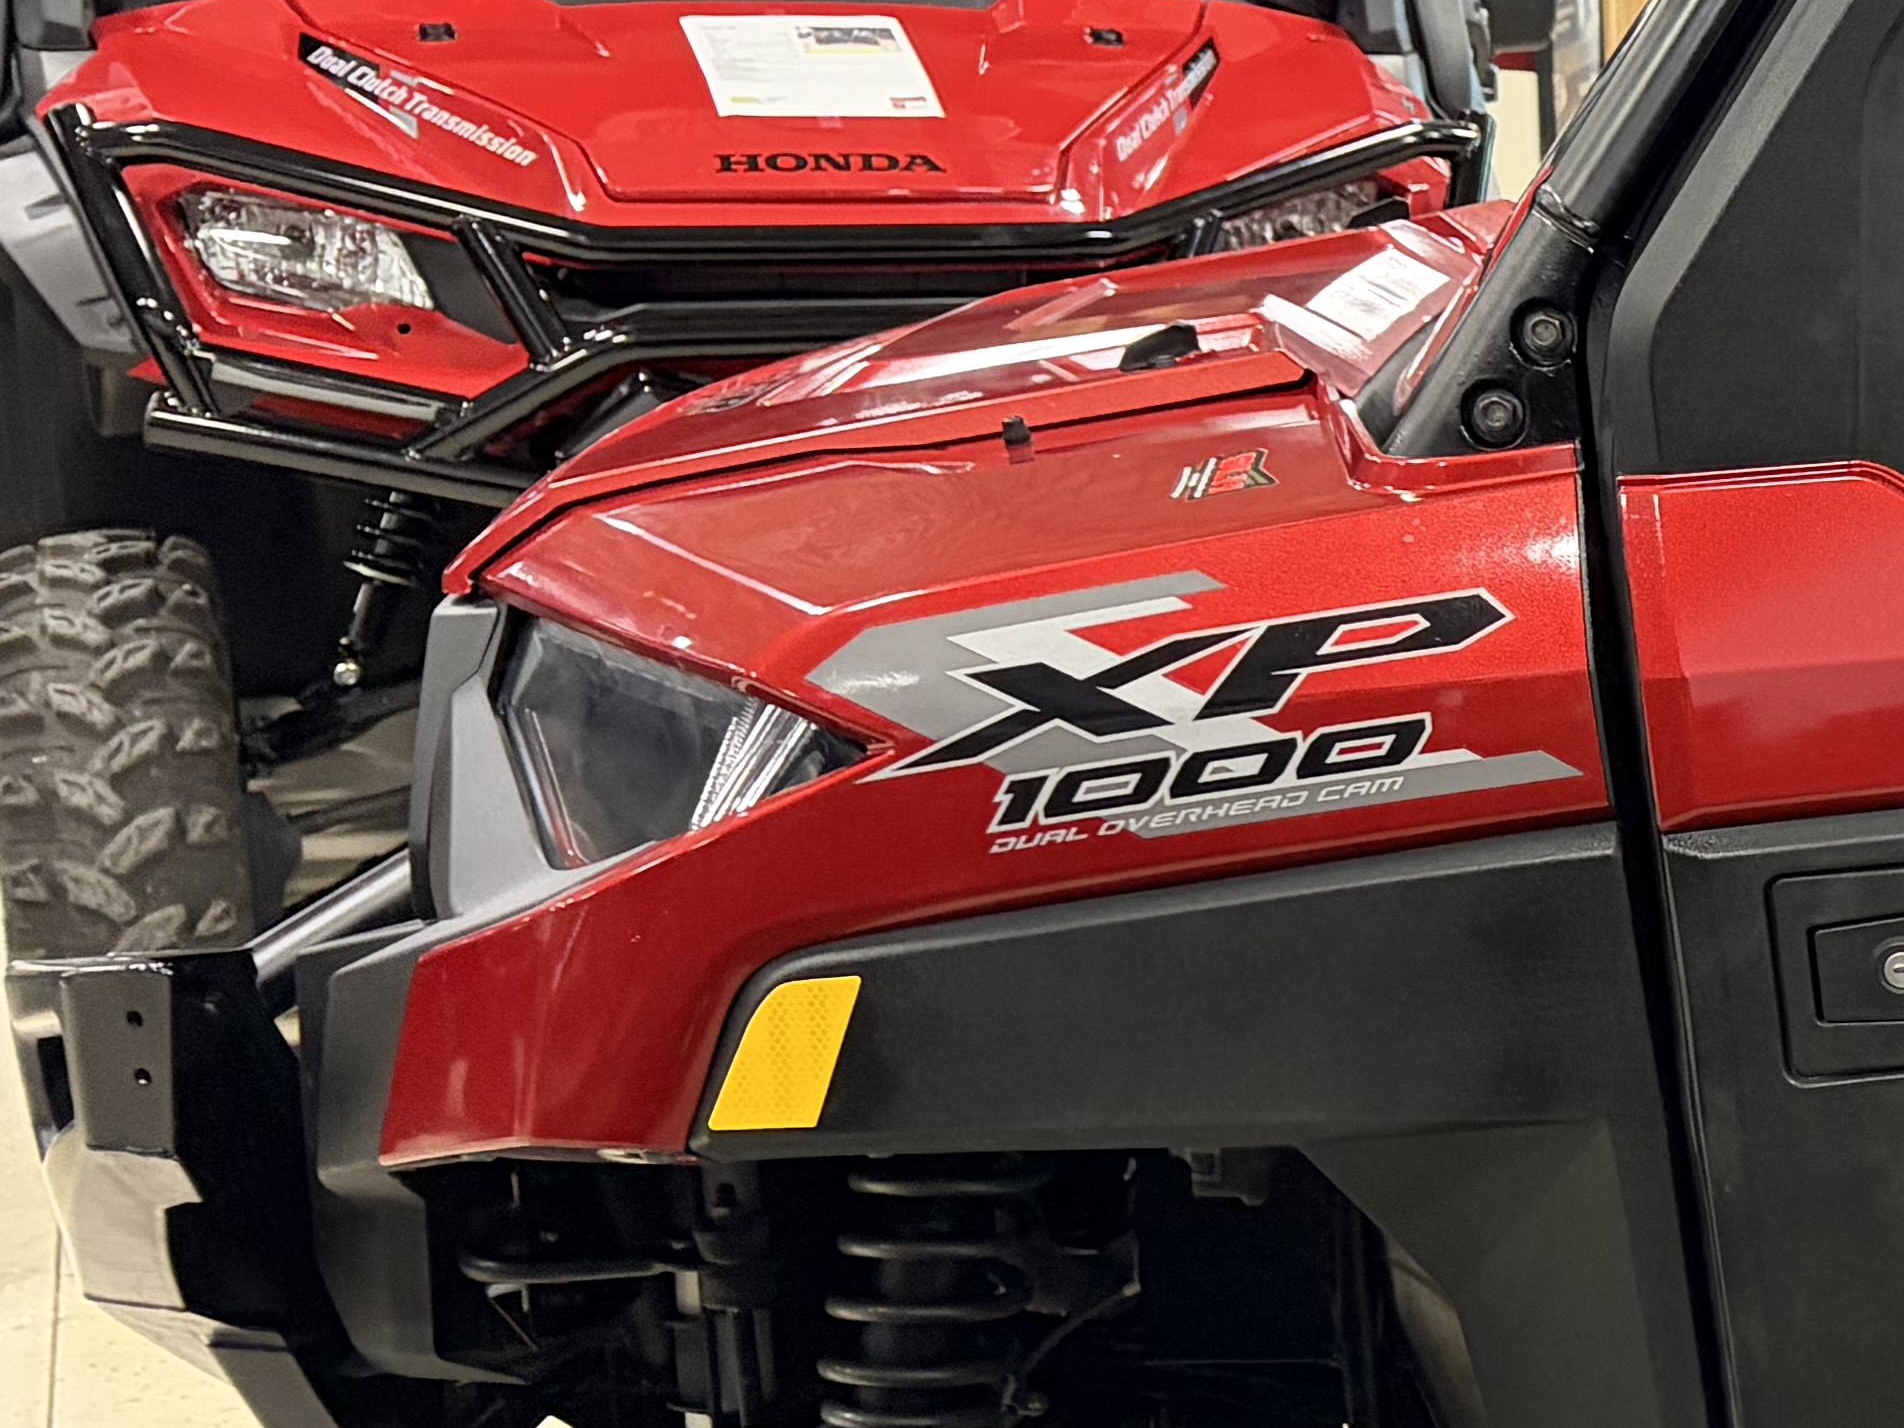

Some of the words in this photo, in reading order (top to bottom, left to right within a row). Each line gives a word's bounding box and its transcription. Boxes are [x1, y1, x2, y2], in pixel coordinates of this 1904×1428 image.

[306, 45, 354, 81] Dual
[346, 65, 409, 105] Clutch
[403, 91, 540, 167] Transmission
[714, 152, 948, 173] HONDA
[868, 590, 1512, 779] XP
[987, 714, 1431, 834] 1000
[988, 826, 1089, 854] DUAL
[1097, 790, 1307, 836] OVERHEAD
[1315, 776, 1405, 803] CAM
